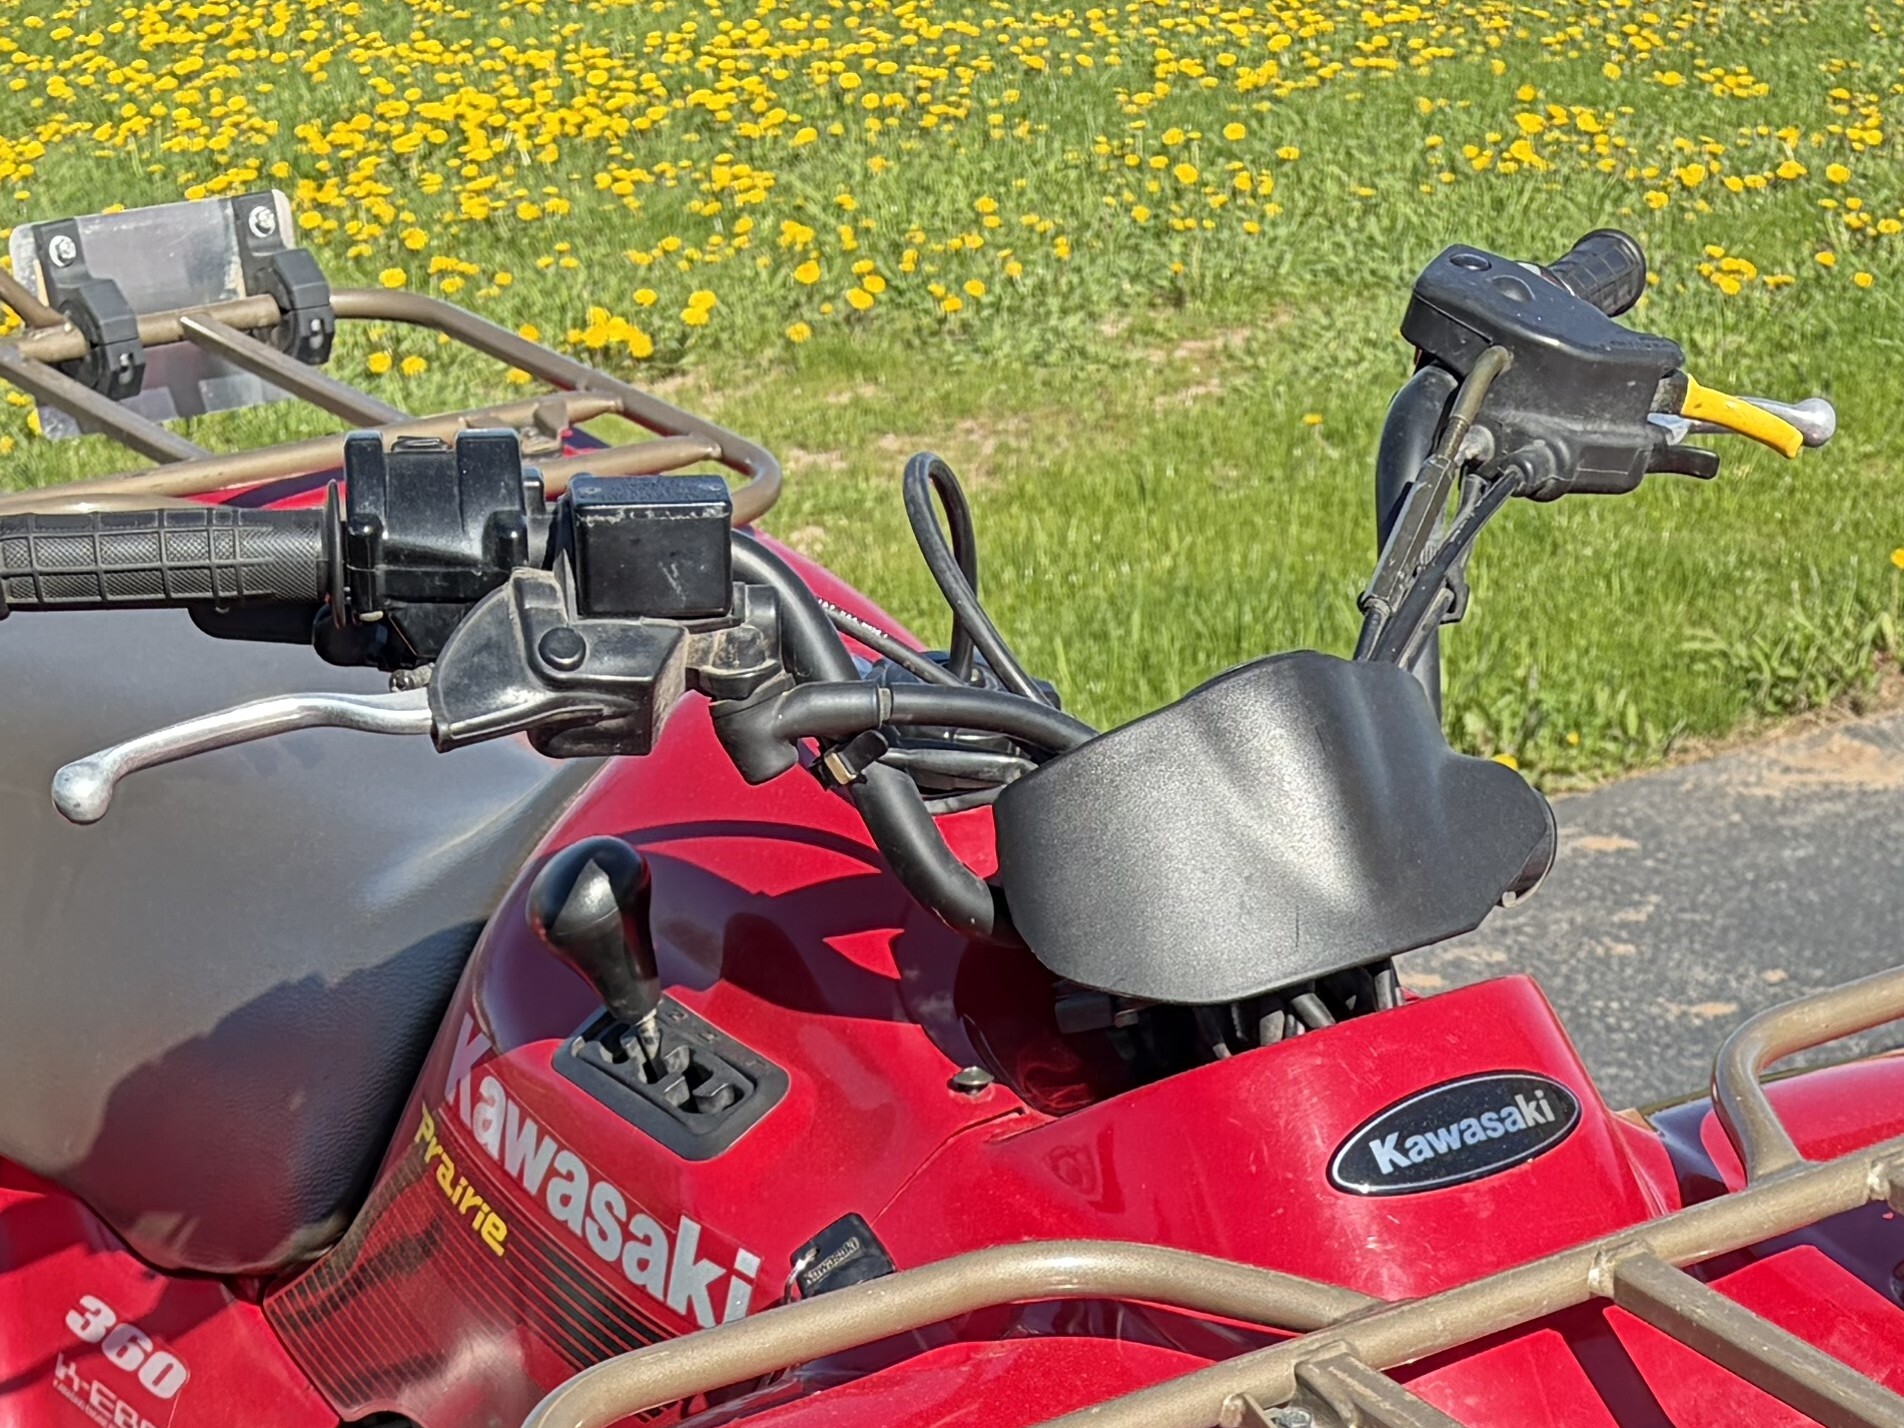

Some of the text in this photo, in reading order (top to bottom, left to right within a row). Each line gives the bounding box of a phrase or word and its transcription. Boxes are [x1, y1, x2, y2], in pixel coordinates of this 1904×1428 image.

[414, 1102, 512, 1256] Prairie
[446, 1012, 762, 1330] Kawasaki
[1369, 1089, 1556, 1175] Kawasaki
[65, 1294, 189, 1400] 360
